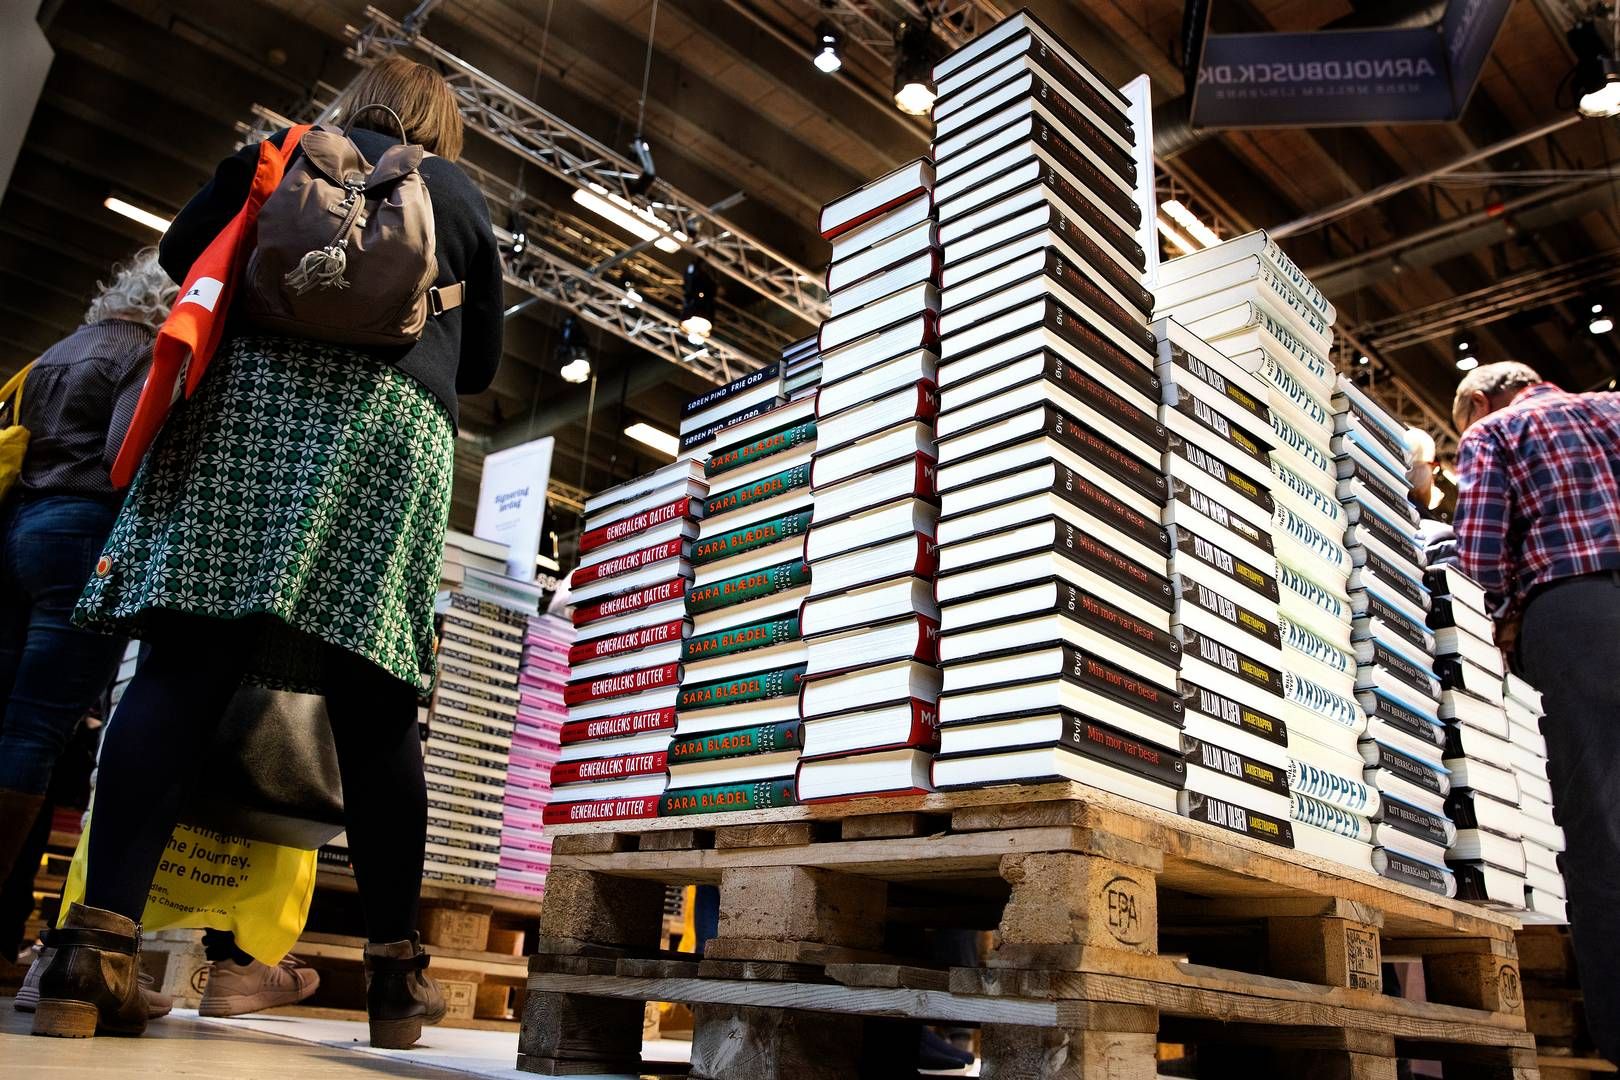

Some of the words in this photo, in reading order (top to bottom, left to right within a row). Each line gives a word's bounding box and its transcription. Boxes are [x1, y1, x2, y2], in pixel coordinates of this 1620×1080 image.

[687, 395, 709, 411] SØREN
[710, 388, 727, 401] PIND
[731, 380, 747, 392] FRIE
[748, 372, 763, 385] ORD
[684, 431, 707, 446] SØREN
[710, 451, 738, 469] SARA
[743, 434, 785, 456] BLÆDEL
[710, 496, 737, 513] SARA
[742, 479, 783, 500] BLÆDEL
[606, 510, 647, 540] GENERALENS
[649, 504, 676, 525] DATTER
[697, 540, 727, 557] SARA
[731, 524, 776, 548] BLÆDEL
[1287, 513, 1343, 566] KROPPEN
[598, 553, 639, 578] GENERALENS
[641, 544, 668, 566] DATTER
[600, 590, 642, 616] GENERALENS
[643, 584, 670, 605] DATTER
[690, 586, 722, 603] SARA
[724, 575, 769, 595] BLÆDEL
[1198, 584, 1218, 614] ALLAN
[1218, 594, 1237, 623] OLSEN
[1280, 566, 1341, 618] KROPPEN
[1082, 596, 1099, 612] Min
[1100, 604, 1117, 622] mor
[1118, 616, 1132, 629] var
[1134, 620, 1154, 641] besat
[596, 630, 639, 654] GENERALENS
[640, 623, 668, 645] DATTER
[688, 638, 718, 655] SARA
[722, 626, 767, 648] BLÆDEL
[1200, 636, 1220, 664] ALLAN
[1219, 646, 1240, 673] OLSEN
[1289, 622, 1347, 672] KROPPEN
[1074, 651, 1082, 676] Øvig
[592, 676, 634, 696] GENERALENS
[636, 668, 664, 688] DATTER
[682, 691, 712, 705] SARA
[716, 680, 760, 698] BLÆDEL
[1088, 661, 1104, 678] Min
[1106, 671, 1121, 686] mor
[1122, 680, 1137, 691] var
[1138, 684, 1158, 702] besat
[1200, 689, 1220, 718] ALLAN
[1220, 698, 1240, 726] OLSEN
[1294, 674, 1356, 726] KROPPEN
[588, 720, 630, 737] GENERALENS
[633, 712, 660, 732] DATTER
[1073, 716, 1081, 743] Øvig
[674, 742, 703, 756] SARA
[707, 733, 752, 752] BLÆDEL
[1087, 725, 1103, 740] Min
[1106, 731, 1121, 748] mor
[1122, 740, 1137, 755] var
[1138, 744, 1160, 764] besat
[1202, 743, 1222, 771] ALLAN
[1222, 750, 1242, 778] OLSEN
[579, 762, 623, 778] GENERALENS
[625, 755, 654, 774] DATTER
[667, 796, 696, 811] SARA
[701, 792, 748, 807] BLÆDEL
[1296, 762, 1368, 810] KROPPEN
[570, 804, 614, 820] GENERALENS
[616, 800, 644, 818] DATTER
[1208, 798, 1227, 826] ALLAN
[1227, 804, 1248, 832] OLSEN
[1296, 794, 1360, 839] KROPPEN
[167, 836, 186, 853] he
[190, 843, 251, 870] journey.
[160, 859, 186, 877] are
[190, 866, 248, 888] home."
[159, 896, 194, 913] Changed
